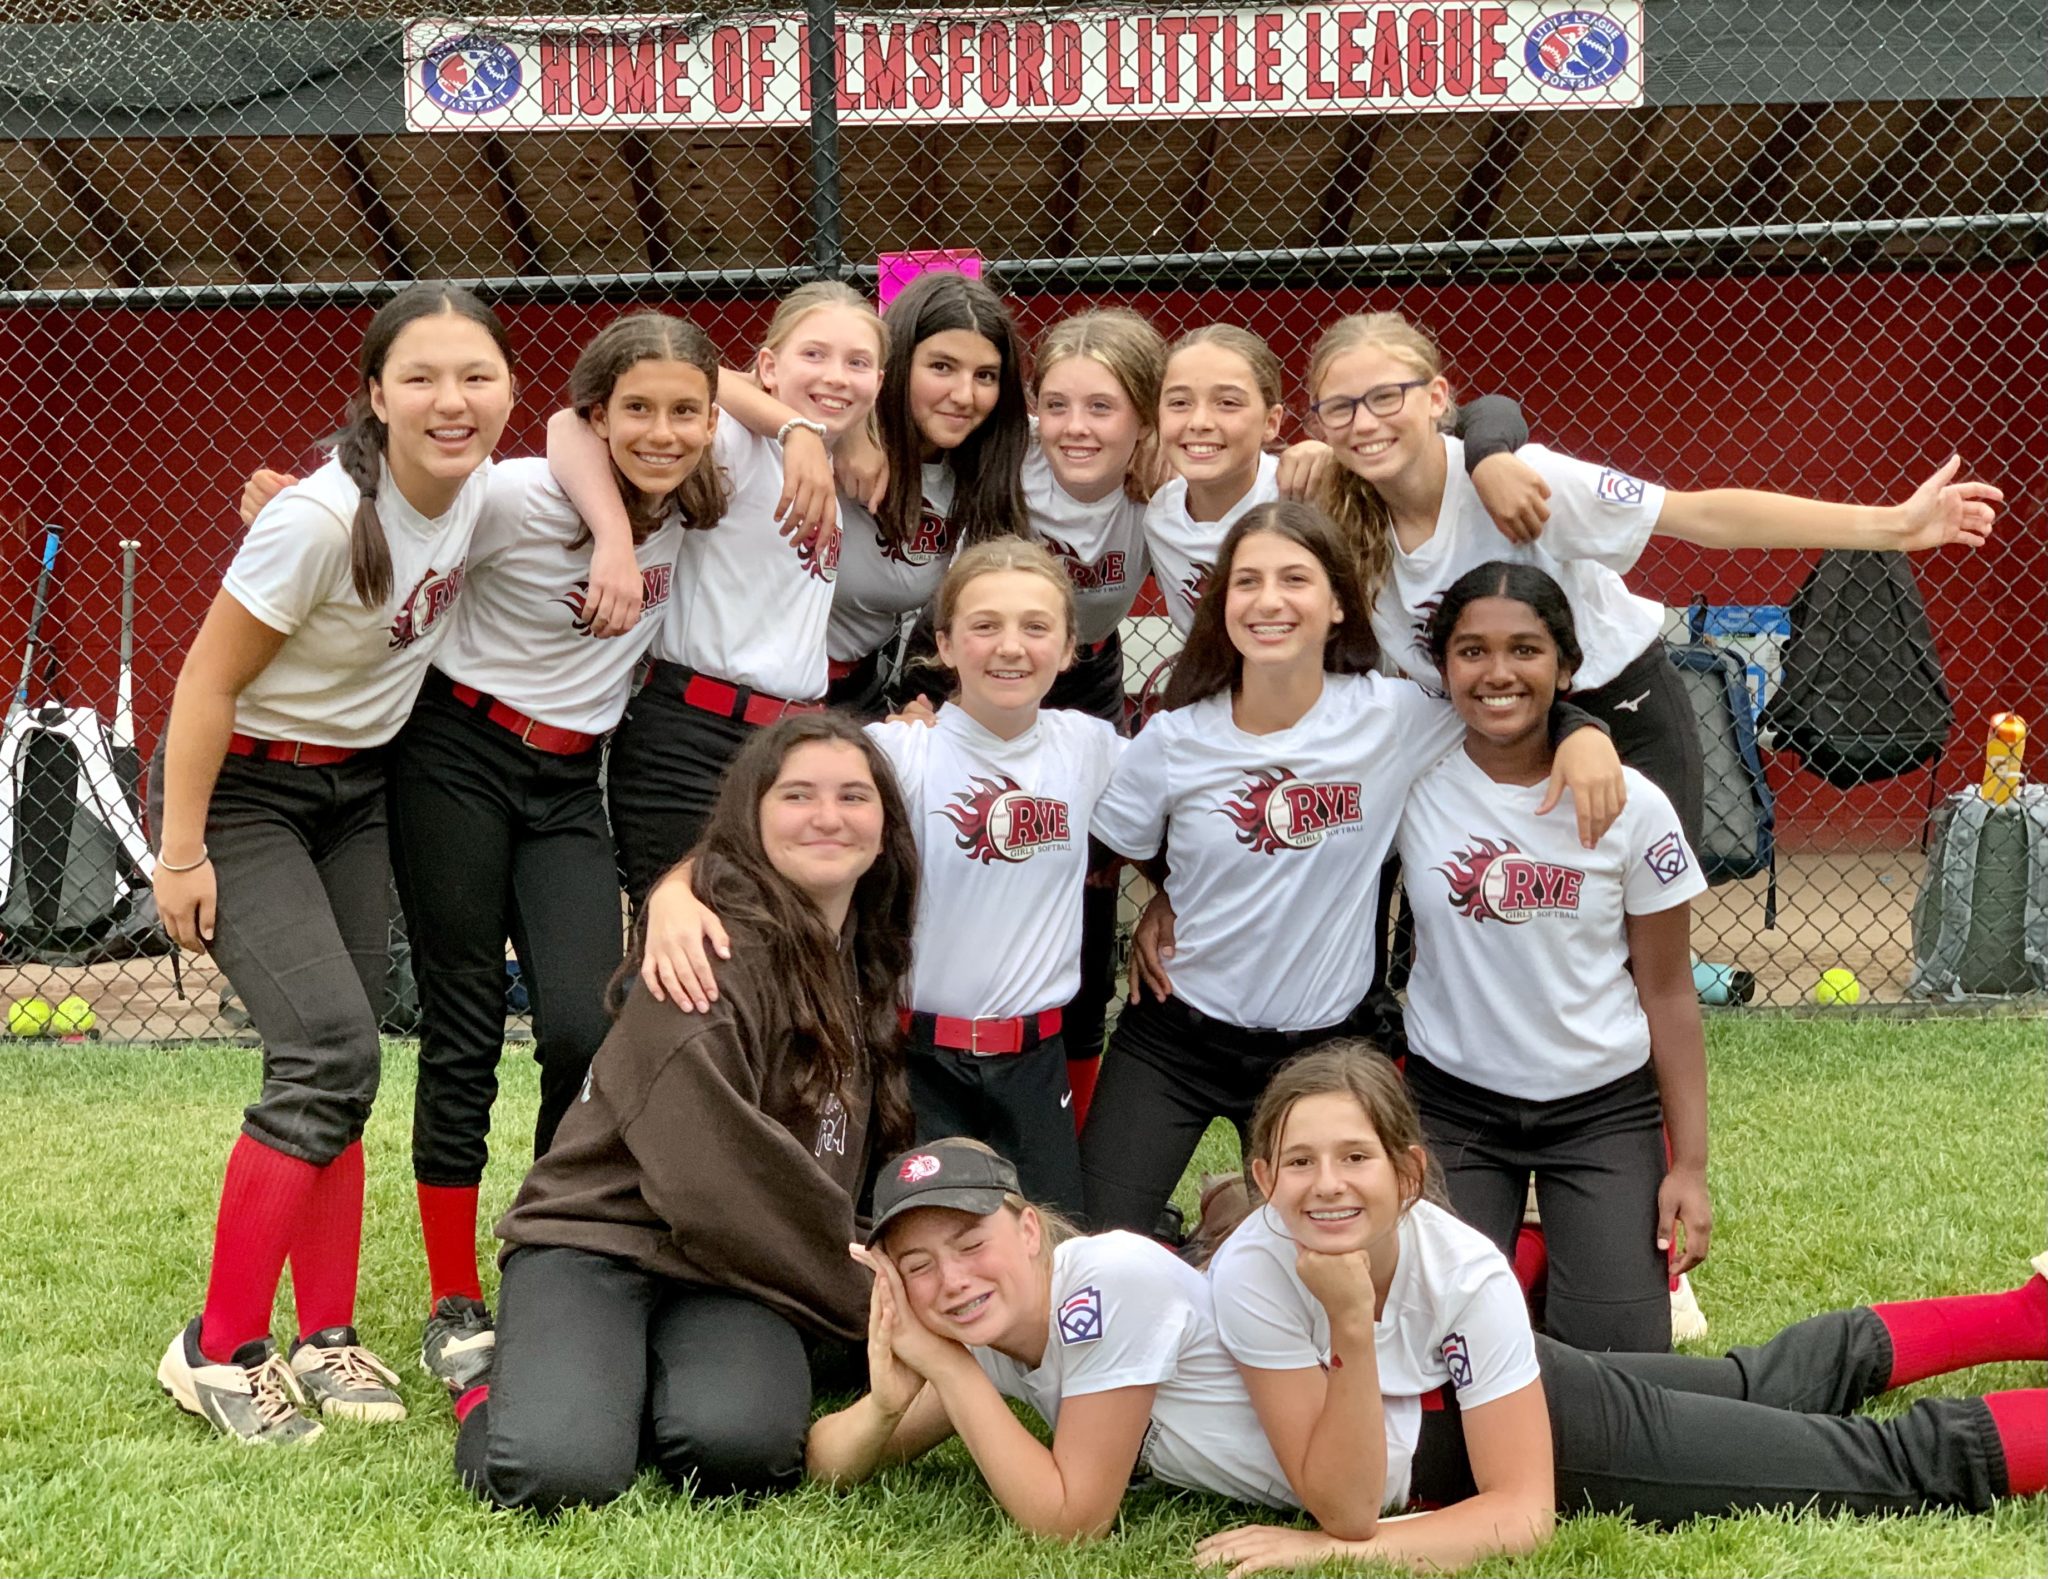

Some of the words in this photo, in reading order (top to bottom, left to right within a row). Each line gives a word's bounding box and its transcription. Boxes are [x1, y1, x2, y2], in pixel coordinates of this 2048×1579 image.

[540, 26, 692, 116] HOME
[712, 25, 777, 114] OF
[1105, 15, 1285, 105] LITTLE
[1305, 8, 1509, 100] LEAGUE
[640, 562, 673, 612] YE
[1004, 796, 1071, 851] RYE
[1282, 781, 1363, 839] RYE
[1010, 847, 1034, 858] GIRLS
[1037, 843, 1072, 853] SOFTBALL
[1295, 833, 1322, 847] GIRLS
[1326, 825, 1364, 839] SOFTBALL
[1499, 859, 1585, 910] RYE
[1505, 910, 1533, 920] GIRLS
[1537, 910, 1580, 920] SOFTBALL
